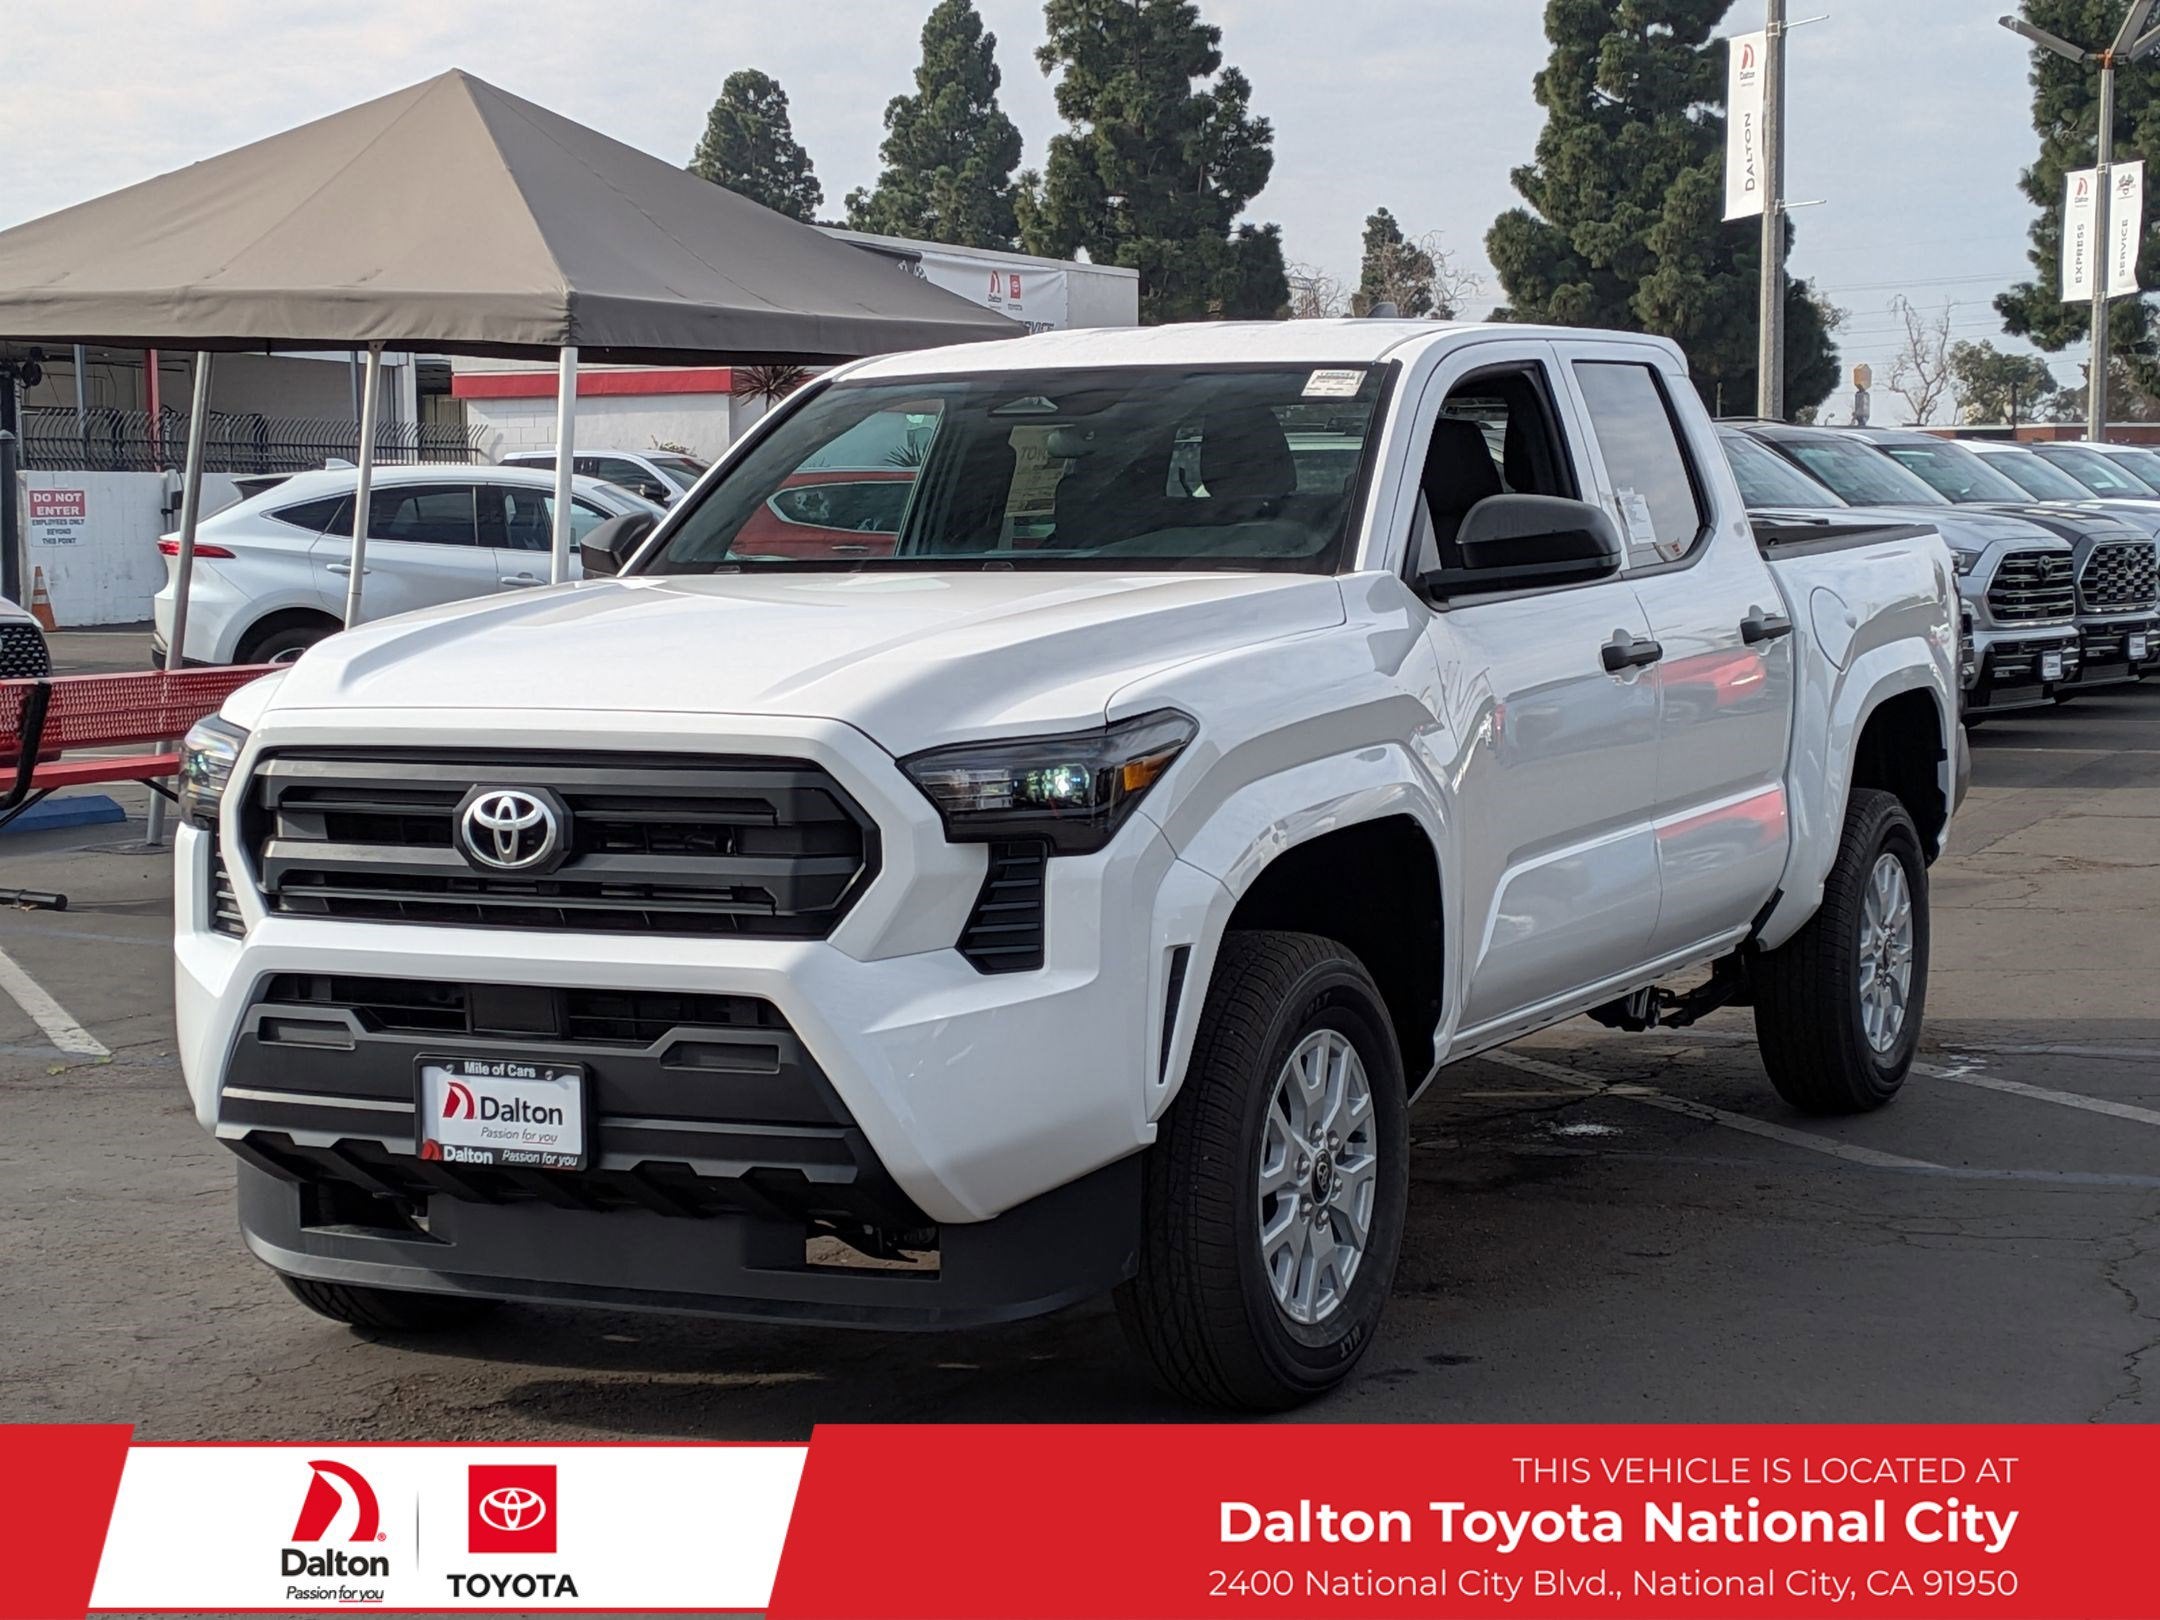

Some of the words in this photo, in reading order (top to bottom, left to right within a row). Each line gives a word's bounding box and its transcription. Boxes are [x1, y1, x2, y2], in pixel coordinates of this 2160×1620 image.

[1745, 113, 1755, 191] DALTON
[2075, 223, 2084, 283] EXPRESS
[2119, 219, 2128, 277] SERVICE
[33, 493, 51, 503] DO
[55, 492, 82, 503] NOT
[36, 506, 80, 516] ENTER
[464, 1061, 489, 1075] Mile
[492, 1063, 505, 1076] of
[507, 1064, 536, 1078] Cars
[480, 1096, 563, 1126] Dalton
[481, 1126, 520, 1140] Passion
[522, 1129, 536, 1142] for
[538, 1132, 558, 1144] you
[443, 1145, 493, 1164] Dalton
[502, 1149, 540, 1163] Passion
[541, 1152, 556, 1166] for
[557, 1154, 578, 1168] you
